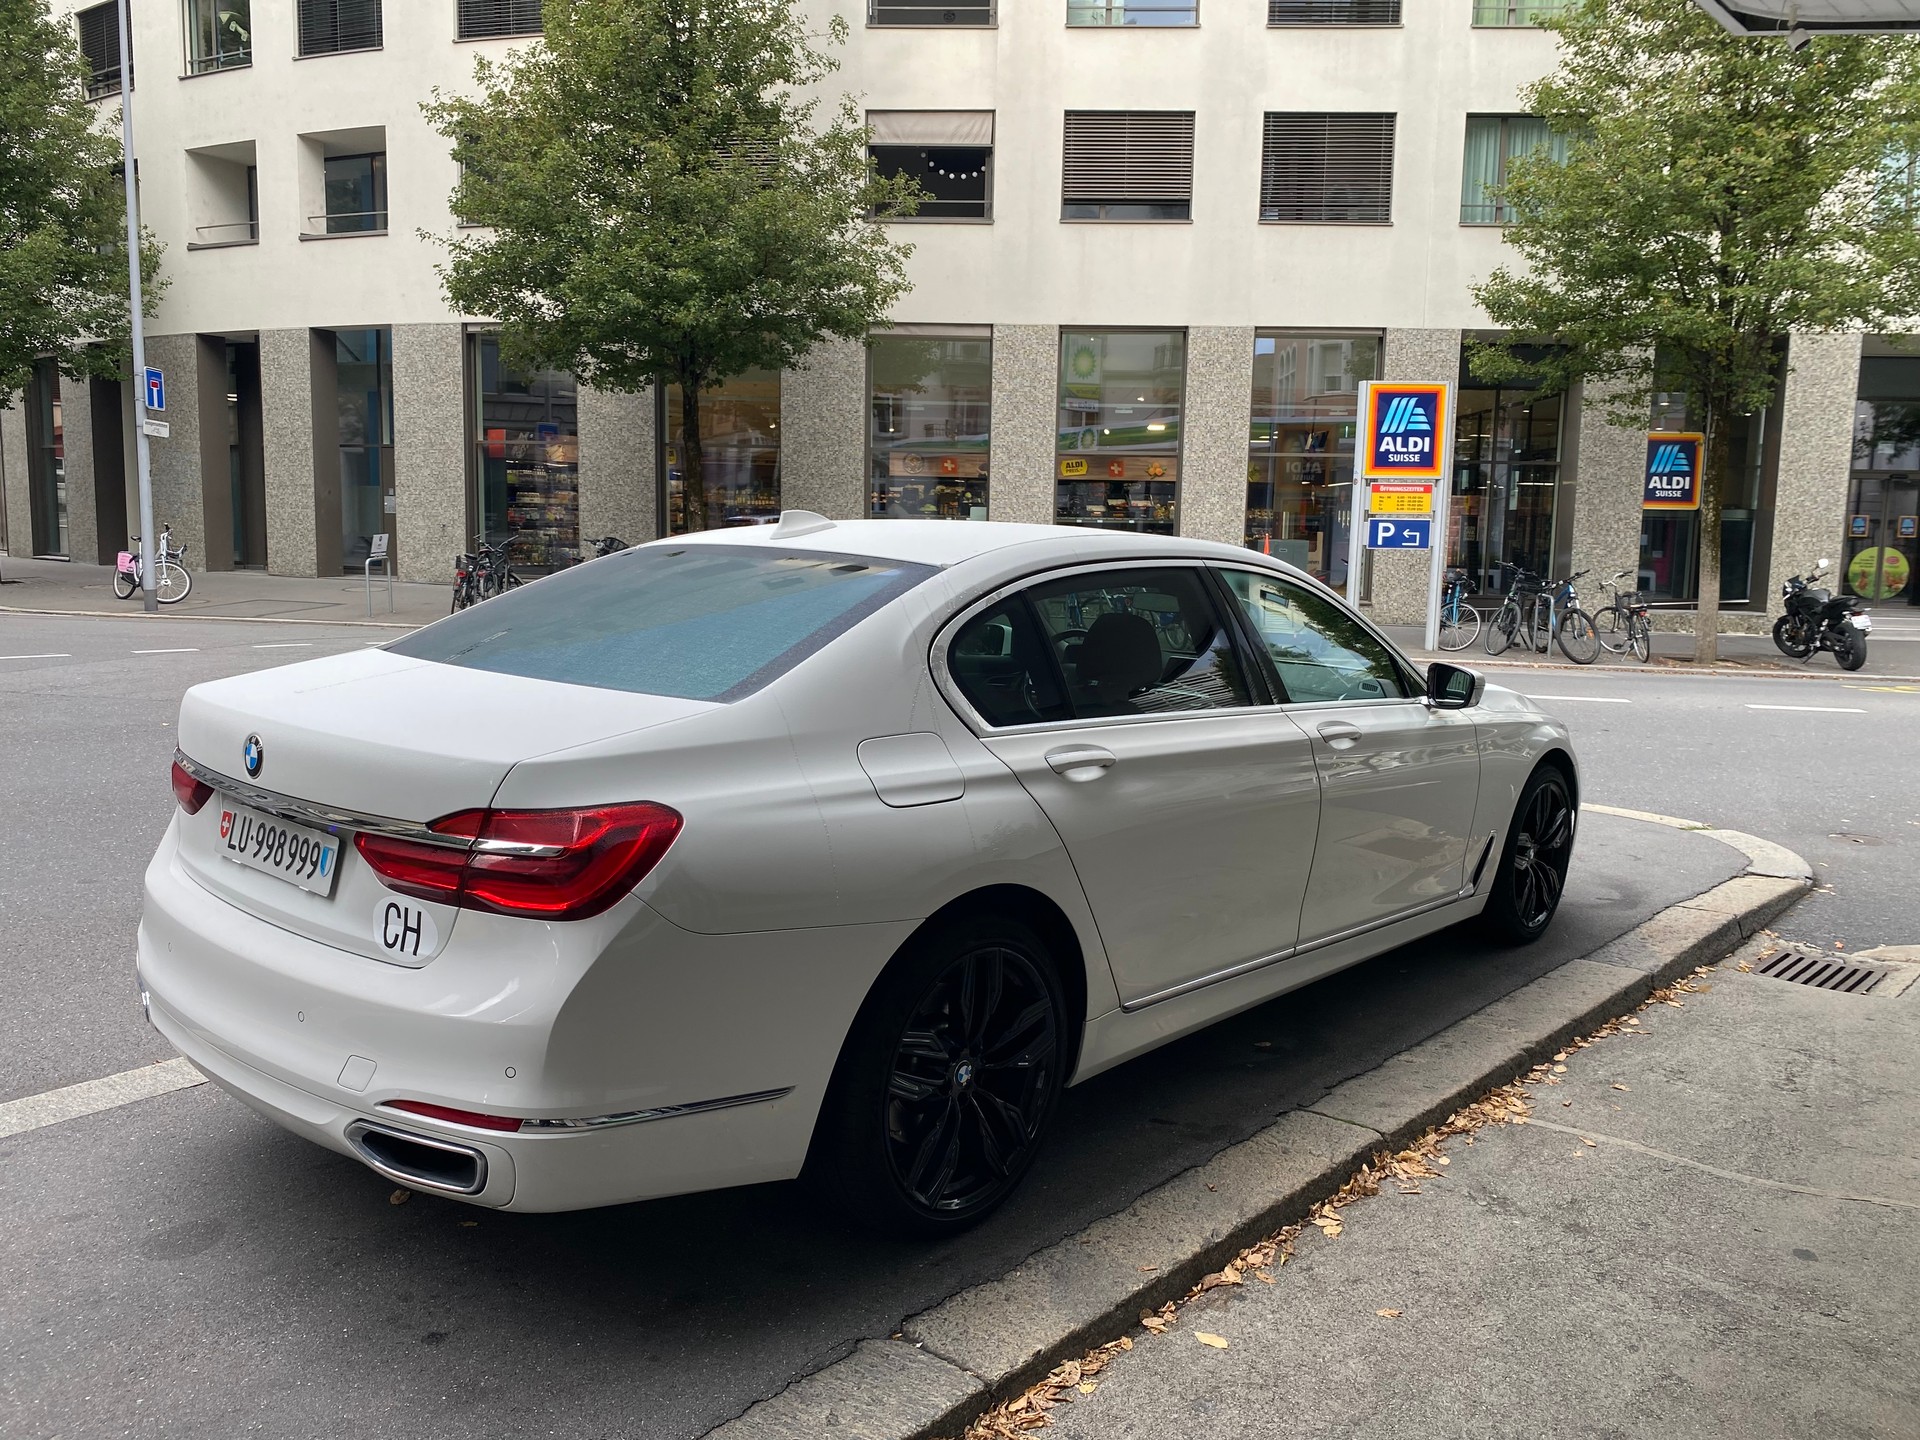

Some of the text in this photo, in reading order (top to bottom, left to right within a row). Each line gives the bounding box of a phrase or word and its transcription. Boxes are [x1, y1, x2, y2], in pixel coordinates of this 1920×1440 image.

[1379, 436, 1430, 452] ALDI
[1388, 454, 1420, 462] SUISSE
[1648, 476, 1690, 489] ALDI
[1377, 522, 1395, 545] P
[384, 902, 421, 956] CH
